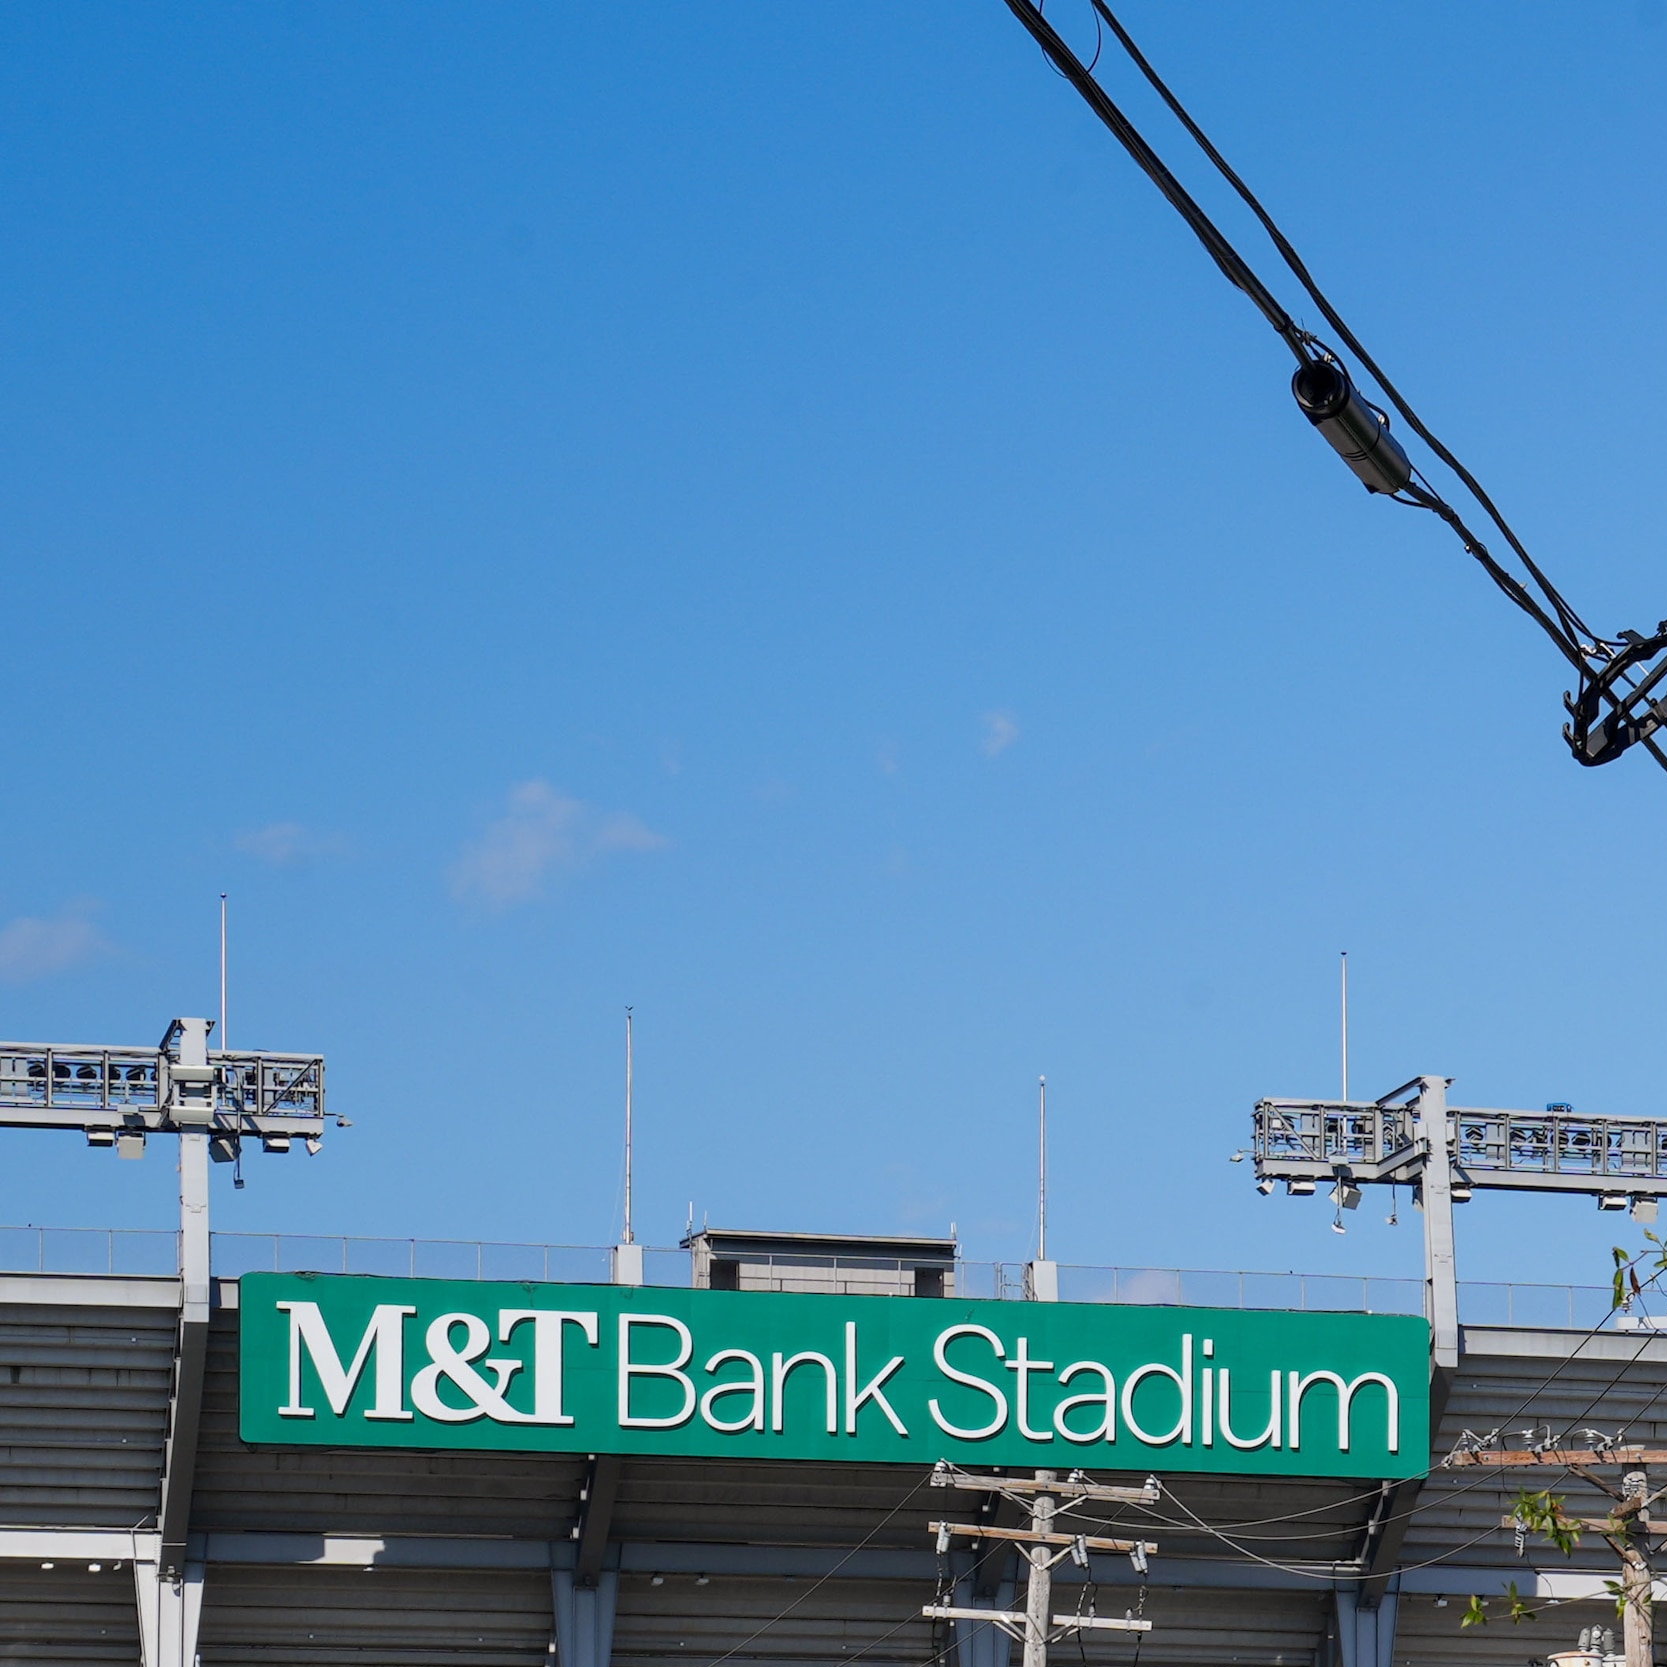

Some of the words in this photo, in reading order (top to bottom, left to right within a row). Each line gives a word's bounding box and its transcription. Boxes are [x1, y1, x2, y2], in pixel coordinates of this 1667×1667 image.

[277, 1301, 597, 1424] M&T
[618, 1313, 908, 1435] Bank
[928, 1324, 1398, 1451] Stadium
